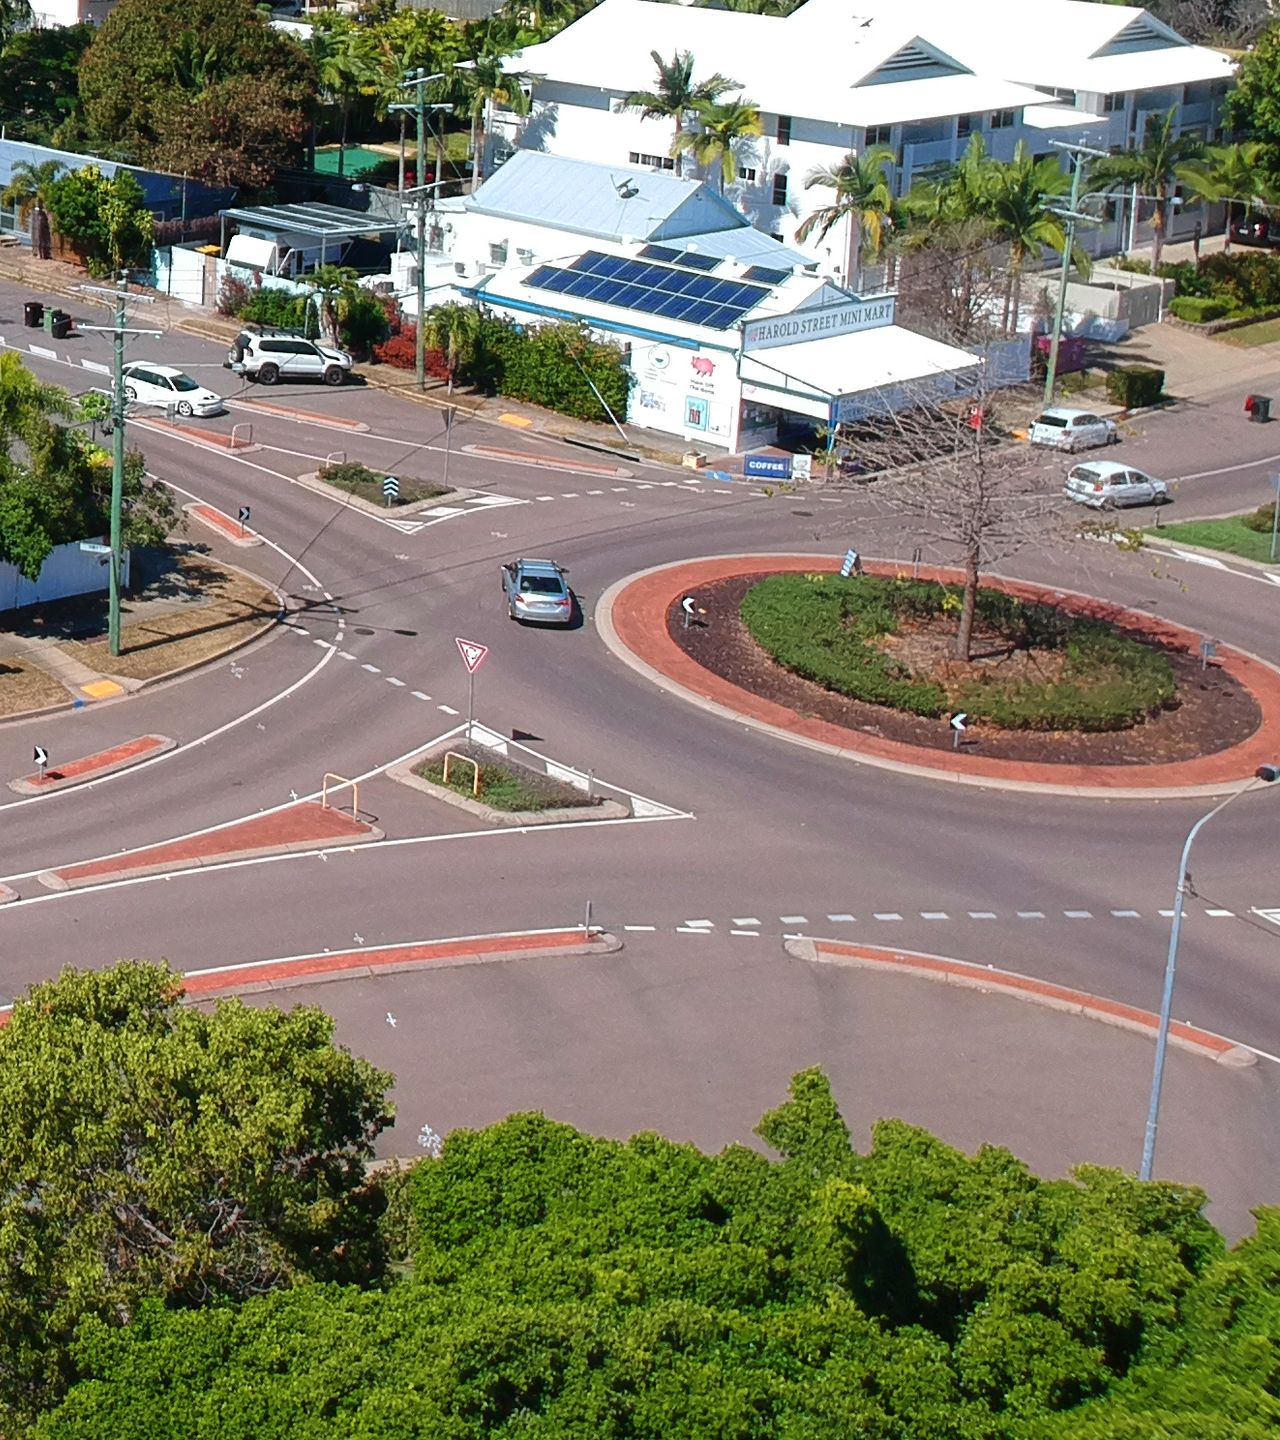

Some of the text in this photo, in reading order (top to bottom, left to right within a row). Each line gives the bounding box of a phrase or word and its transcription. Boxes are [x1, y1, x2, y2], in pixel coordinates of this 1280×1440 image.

[758, 303, 891, 341] HAROLD STREET MINI MART
[749, 461, 784, 471] COFFEE
